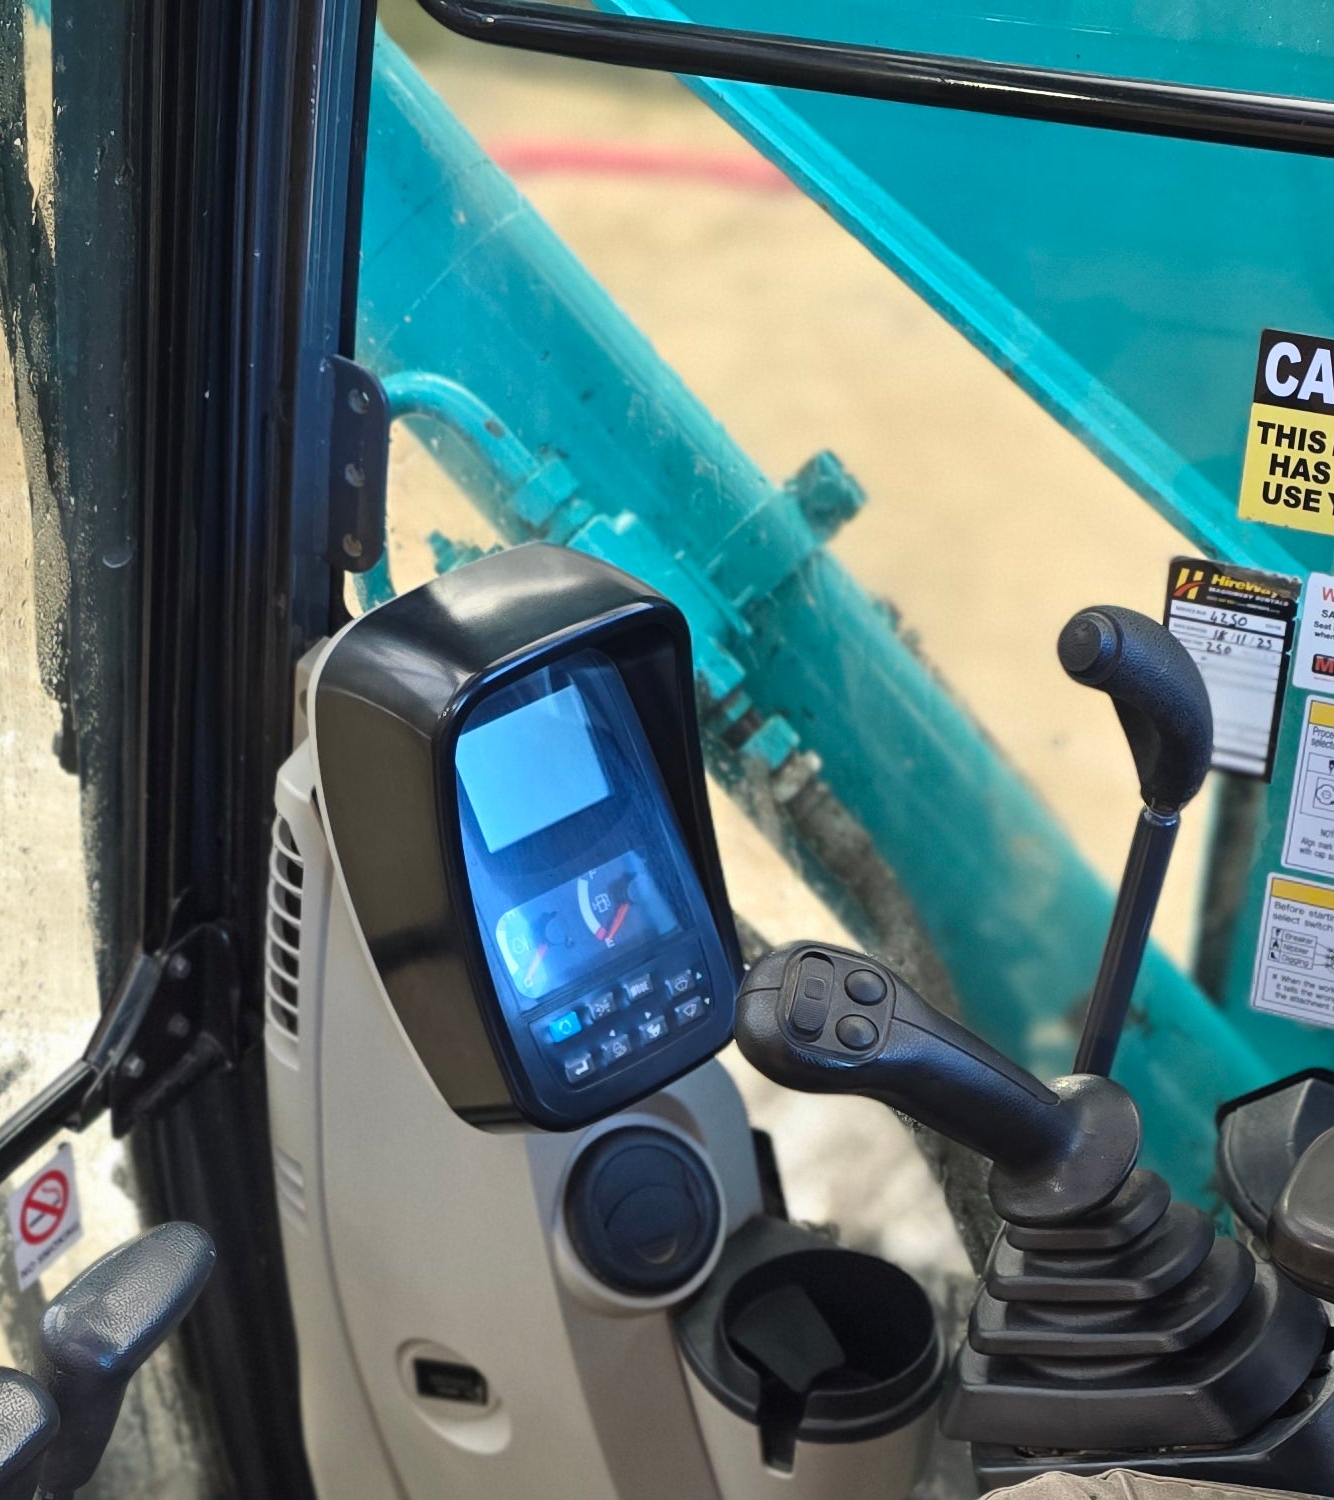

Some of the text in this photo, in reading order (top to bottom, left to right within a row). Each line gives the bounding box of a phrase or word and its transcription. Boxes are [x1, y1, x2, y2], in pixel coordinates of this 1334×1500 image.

[1257, 421, 1327, 454] THIS
[1269, 454, 1331, 484] HAS
[1261, 482, 1323, 512] USE
[1210, 611, 1247, 626] 4250
[1314, 621, 1332, 631] Seat
[1207, 642, 1232, 654] 250
[588, 870, 597, 880] F
[605, 936, 616, 949] E
